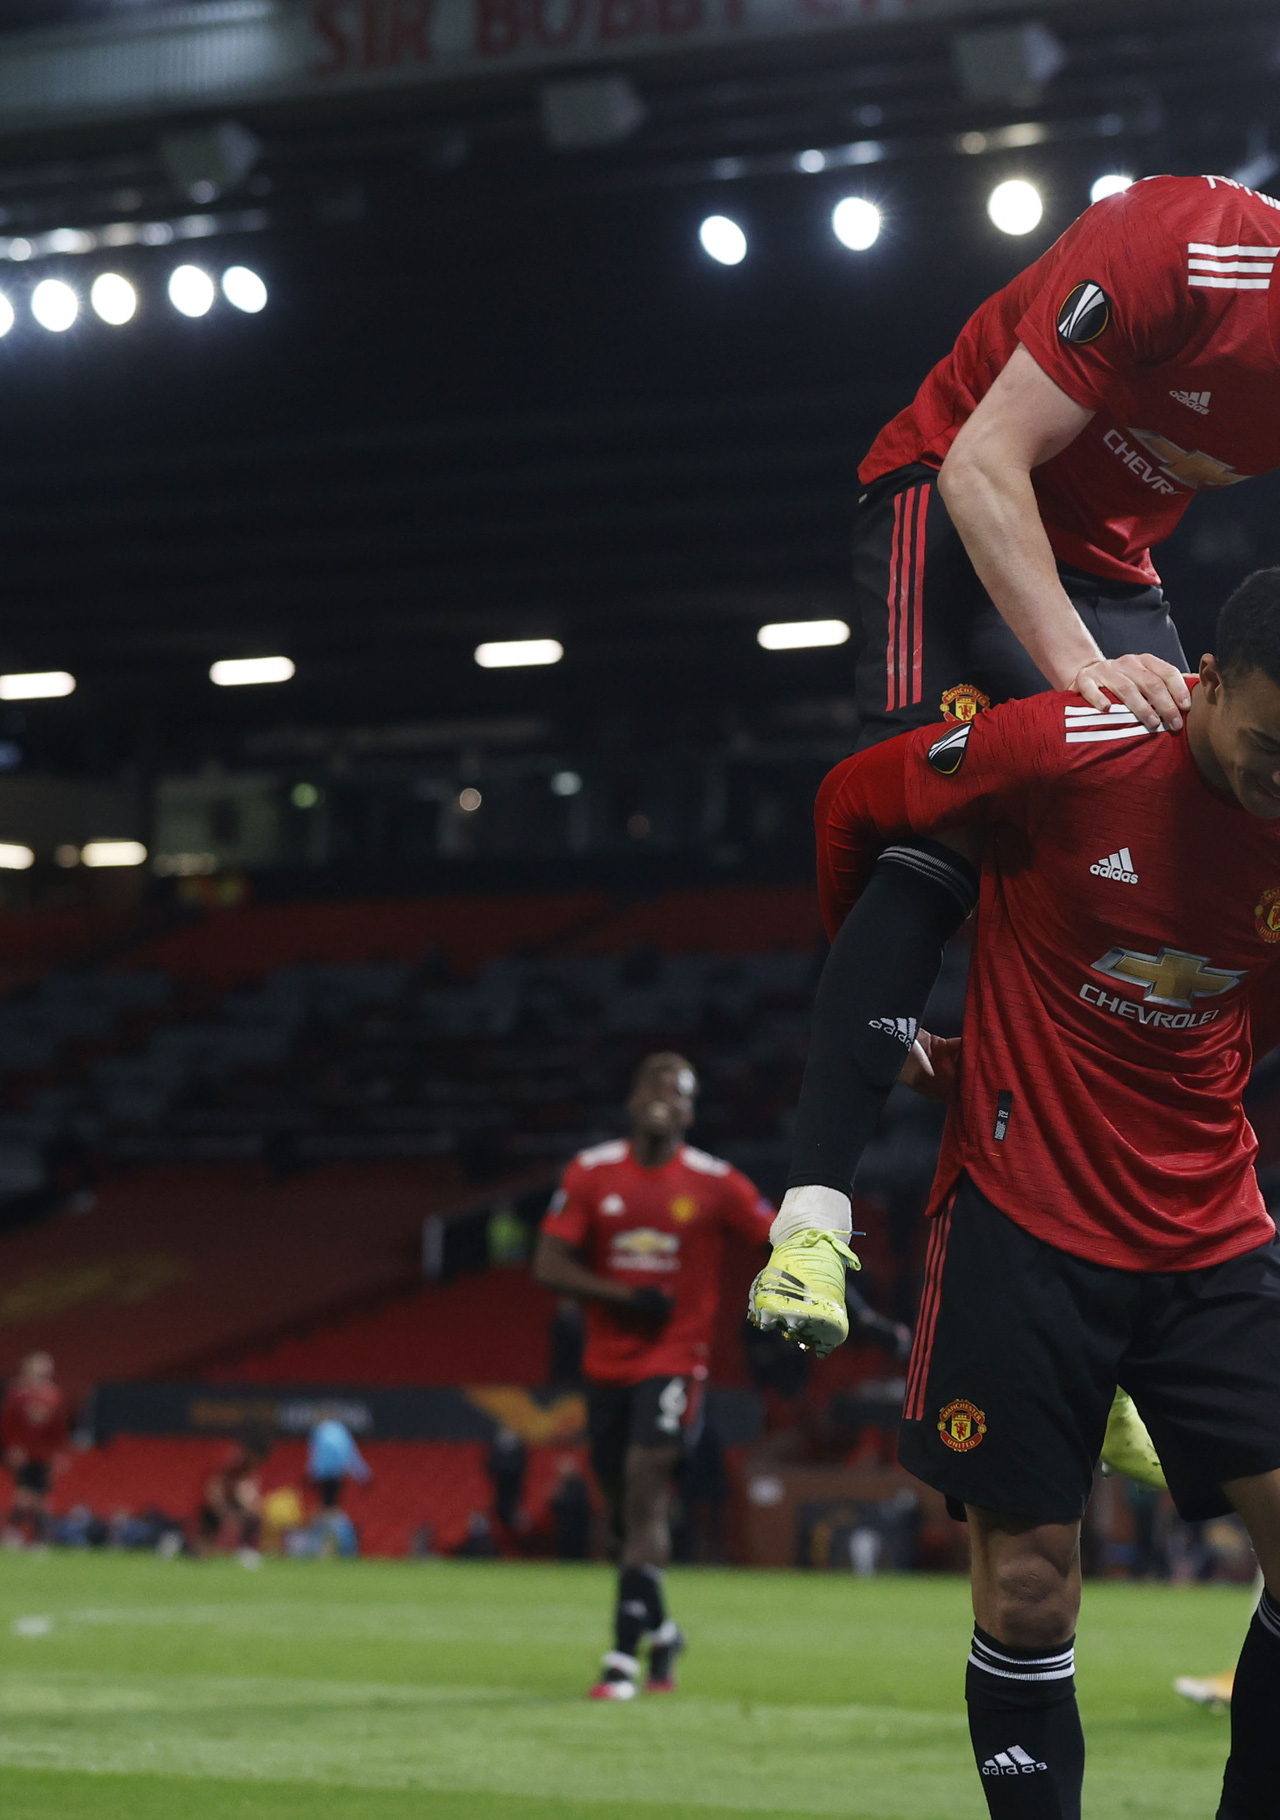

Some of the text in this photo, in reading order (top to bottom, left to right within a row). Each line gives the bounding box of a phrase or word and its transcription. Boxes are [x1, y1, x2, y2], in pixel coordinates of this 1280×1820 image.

[312, 0, 433, 75] SIR
[1169, 390, 1210, 415] adidas
[1102, 428, 1184, 495] CHEVR
[945, 687, 987, 705] MANCHESTER
[1089, 864, 1139, 885] adidas
[943, 1403, 982, 1420] MANCHESTER
[947, 1439, 975, 1449] UNITED
[982, 1762, 1048, 1775] adidas
